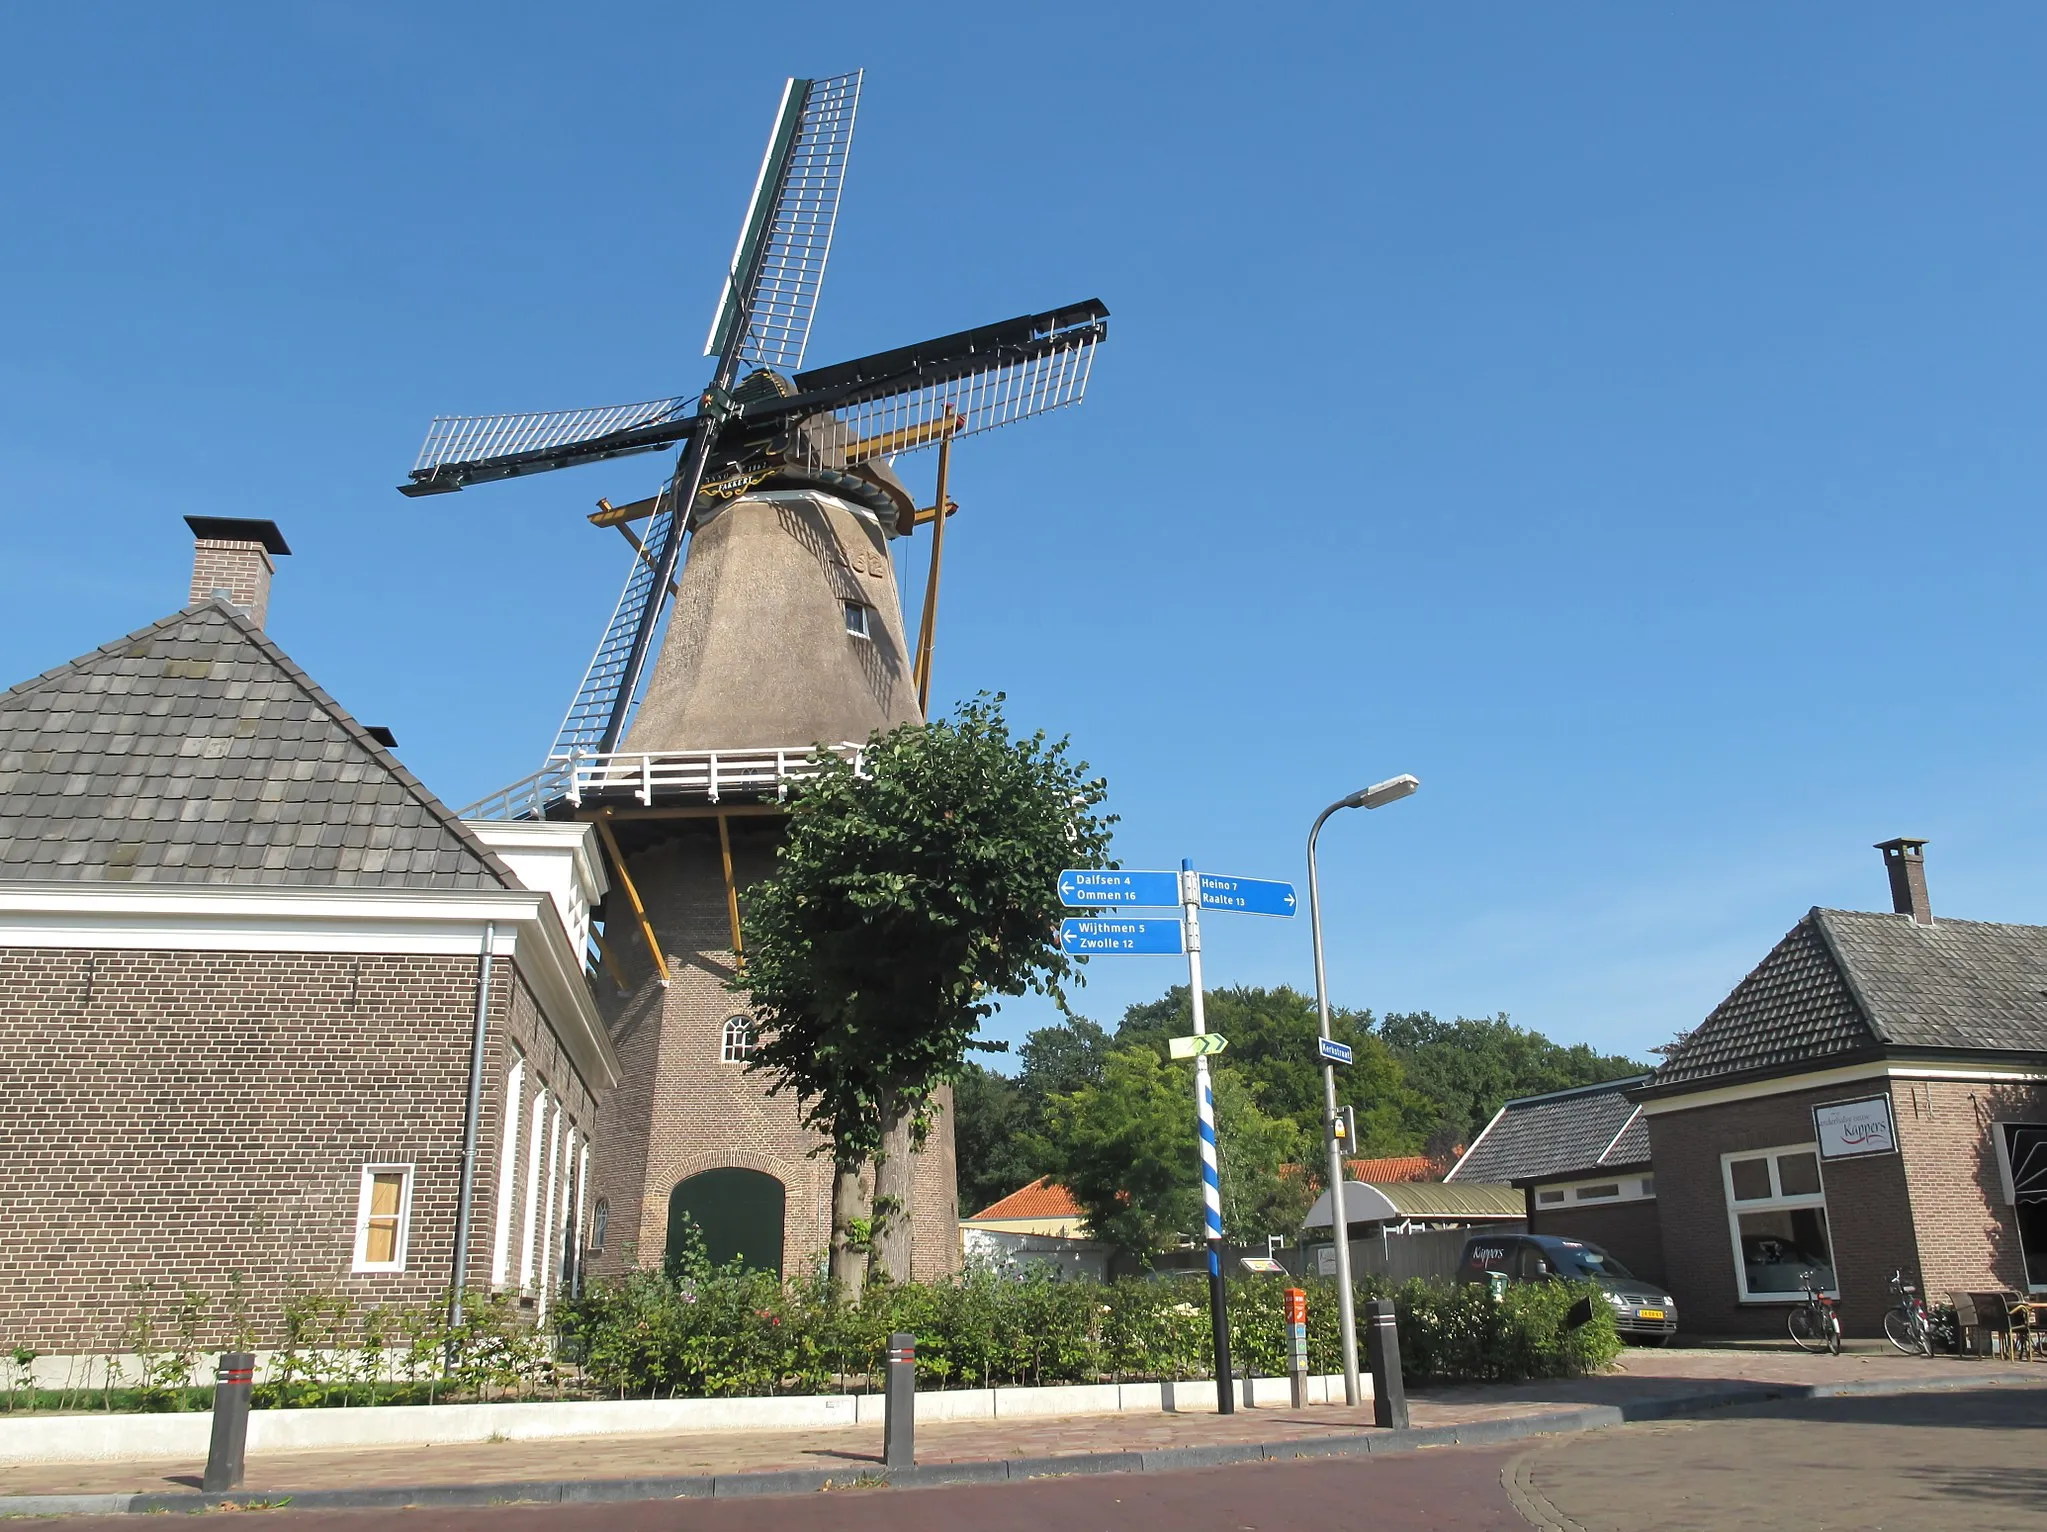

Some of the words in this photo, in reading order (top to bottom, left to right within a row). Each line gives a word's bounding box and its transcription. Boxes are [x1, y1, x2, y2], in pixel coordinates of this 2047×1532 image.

[719, 476, 753, 491] FAKKERT
[1076, 874, 1121, 886] Dalfsen
[1124, 876, 1131, 886] 4
[1201, 878, 1230, 891] Heino
[1232, 882, 1238, 891] 7
[1077, 889, 1121, 900] Ommen
[1124, 891, 1136, 901] 16
[1202, 892, 1234, 906] Raalte
[1236, 897, 1246, 906] 13
[1078, 922, 1136, 936] Wijthmen
[1139, 924, 1145, 933] 5
[1080, 938, 1120, 948] Zwolle
[1122, 939, 1134, 948] 12
[1843, 1120, 1886, 1143] Kappers
[1496, 1281, 1502, 1292] 5
